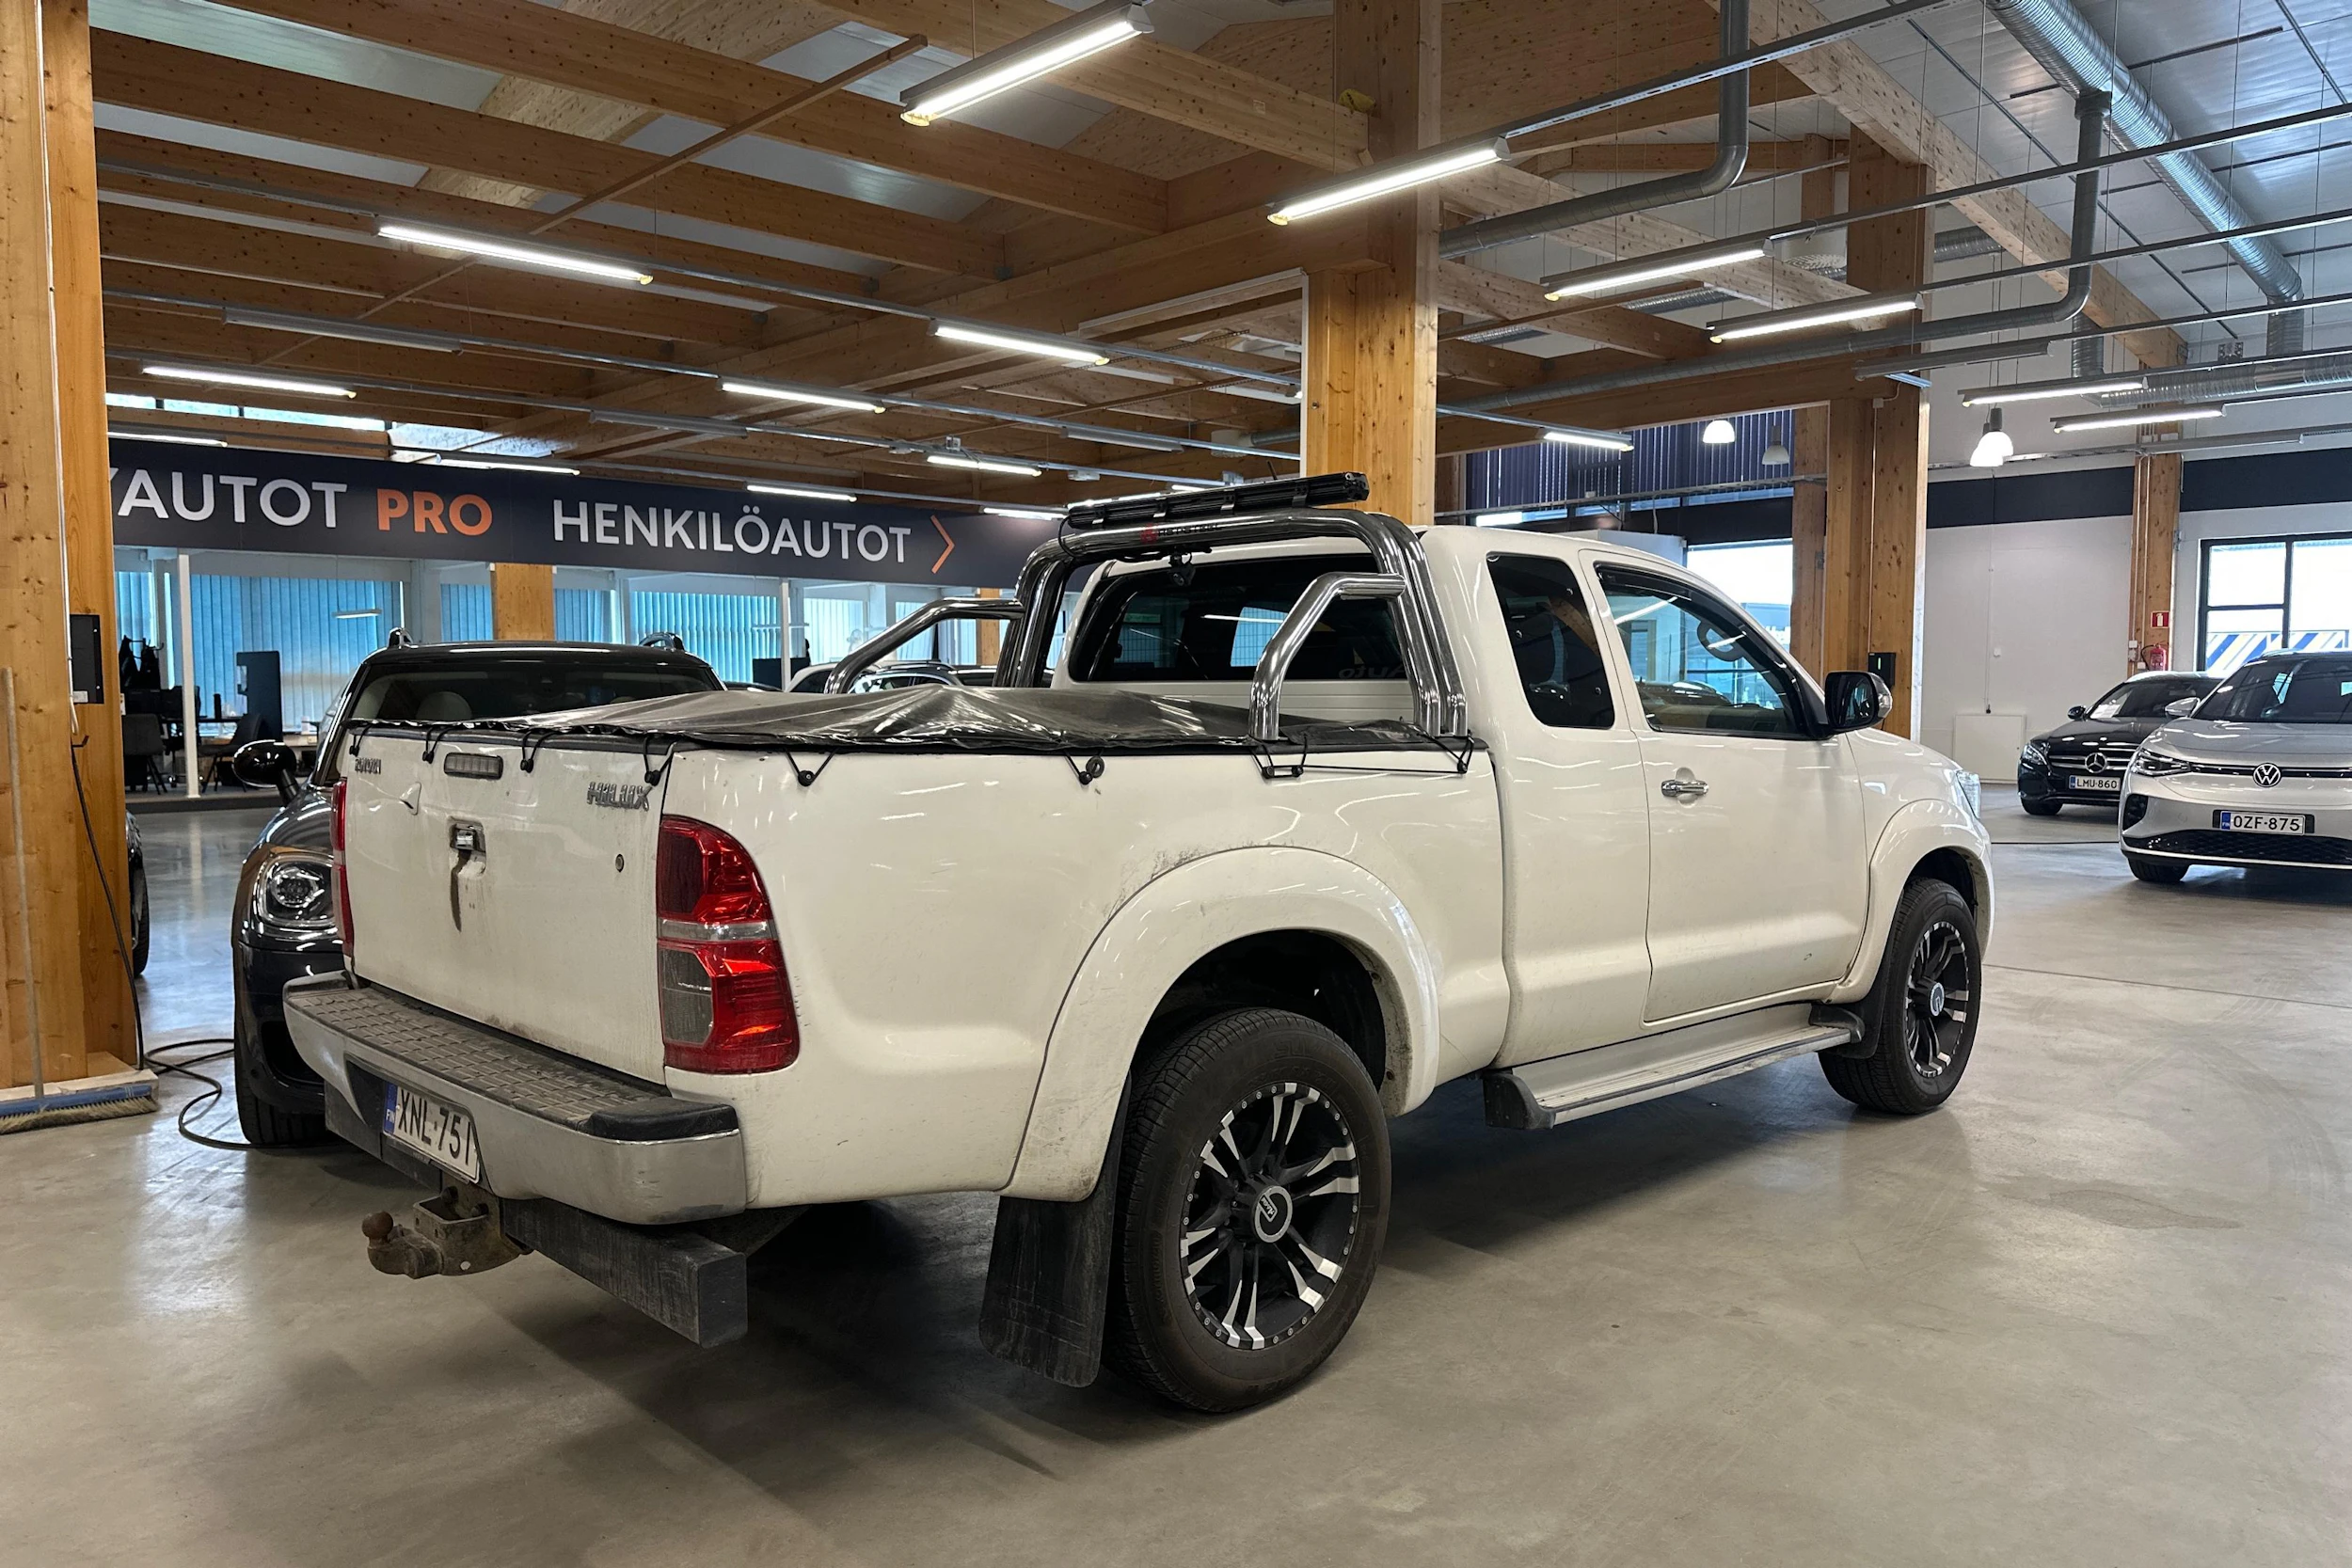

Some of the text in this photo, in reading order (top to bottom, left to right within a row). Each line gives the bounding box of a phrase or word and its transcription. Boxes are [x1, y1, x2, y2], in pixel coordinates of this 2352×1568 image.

[110, 467, 492, 535] AUTOT PRO
[553, 499, 911, 563] HENKILÖAUTOT
[587, 782, 653, 812] HILUX
[2076, 778, 2118, 789] LMU-860
[2233, 816, 2300, 832] OZF-875
[398, 1089, 471, 1166] XNL-751
